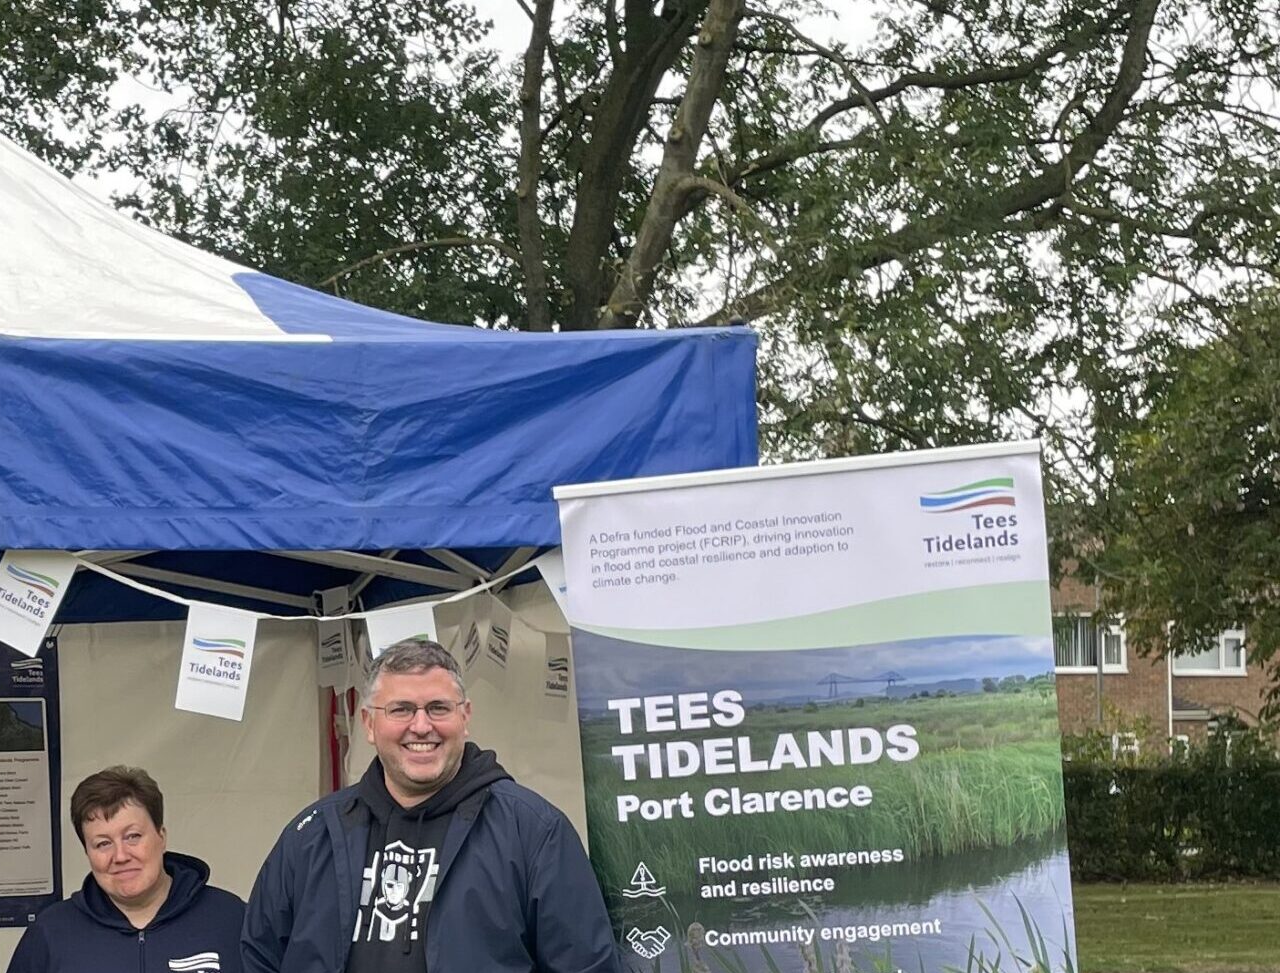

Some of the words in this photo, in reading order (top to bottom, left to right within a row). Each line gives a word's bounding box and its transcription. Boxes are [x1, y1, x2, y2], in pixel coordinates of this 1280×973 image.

[589, 534, 598, 545] A
[599, 531, 631, 544] Defra
[633, 528, 672, 541] funded
[675, 523, 708, 536] Flood
[710, 521, 733, 533] and
[735, 517, 780, 531] Coastal
[782, 511, 843, 526] Innovation
[971, 513, 1019, 530] Tees
[590, 544, 656, 559] Programme
[658, 540, 697, 554] project
[753, 531, 792, 545] driving
[794, 525, 855, 540] innovation
[923, 529, 1020, 553] Tidelands
[591, 562, 601, 574] in
[603, 559, 632, 572] flood
[634, 557, 656, 570] and
[658, 554, 699, 567] coastal
[701, 549, 757, 563] resilience
[759, 546, 782, 559] and
[784, 542, 835, 558] adaption
[837, 541, 849, 552] to
[592, 575, 632, 589] climate
[634, 572, 680, 586] change.
[27, 589, 51, 609] Tees
[189, 662, 241, 681] Tidelands
[218, 656, 243, 671] Tees
[608, 689, 745, 735] TEES
[611, 723, 920, 781] TIDELANDS
[617, 795, 694, 823] Port
[703, 783, 874, 818] Clarence
[698, 855, 753, 874] Flood
[759, 852, 794, 870] risk
[800, 849, 904, 868] awareness
[700, 880, 737, 898] and
[742, 876, 835, 896] resilience
[704, 925, 815, 947] Community
[820, 919, 942, 943] engagement
